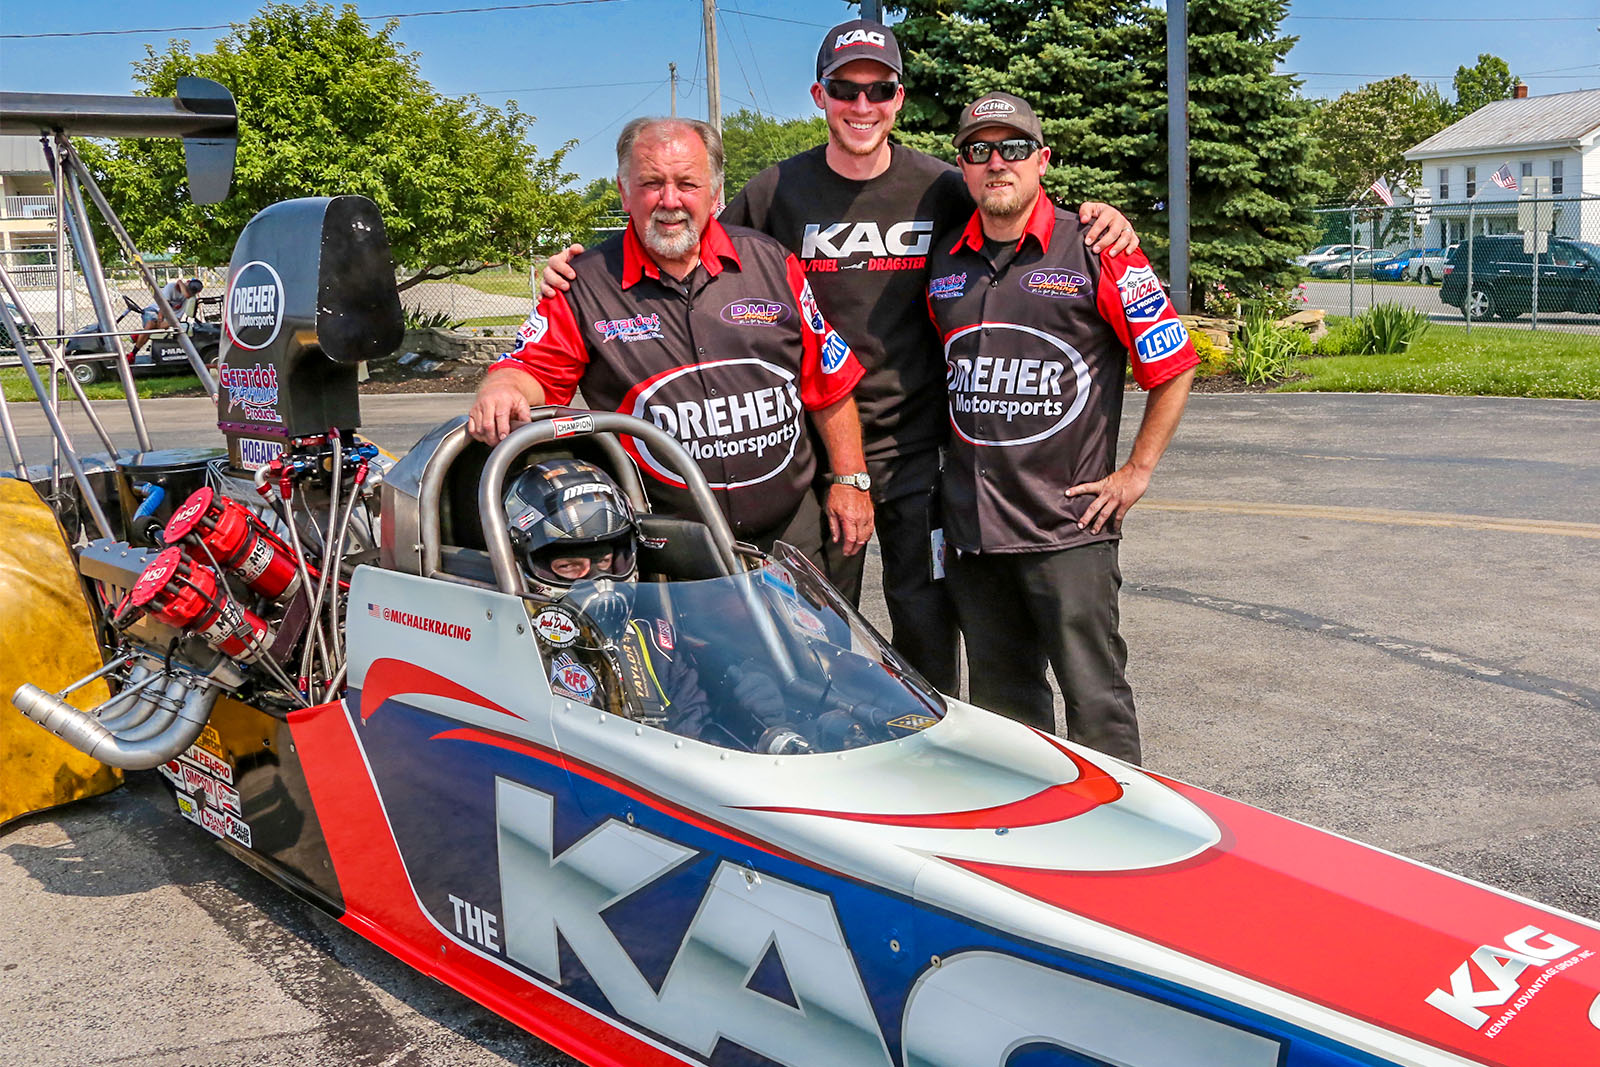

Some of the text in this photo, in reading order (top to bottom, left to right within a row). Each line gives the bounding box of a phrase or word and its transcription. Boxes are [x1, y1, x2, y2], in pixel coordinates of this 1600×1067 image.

[835, 29, 885, 49] KAG
[979, 102, 1010, 113] DREHER
[801, 221, 934, 258] KAG
[799, 256, 927, 273] A/FUEL DRAGSTER
[1029, 272, 1087, 288] DMP
[1125, 279, 1158, 306] LUCAS
[233, 284, 276, 314] DREHER
[731, 303, 782, 317] DMP
[1126, 305, 1138, 316] OIL
[1143, 304, 1157, 315] INC.
[240, 314, 275, 330] Motorsports
[594, 313, 660, 334] Gerardot
[220, 363, 278, 390] Gerardot
[947, 356, 1065, 396] DREHER
[244, 406, 277, 420] Products
[649, 385, 794, 441] DREHER
[955, 393, 1063, 422] Motorsports
[557, 419, 592, 433] CHAMPION
[242, 440, 282, 464] HOGAN'S
[682, 422, 796, 461] Motorsports
[172, 503, 201, 524] MSD
[250, 538, 267, 566] MSD
[140, 567, 167, 583] MSD
[383, 607, 472, 642] @MICHALEKRACING
[565, 669, 588, 690] RFC
[623, 644, 645, 697] TAYLOR
[199, 751, 230, 779] FEL-PRO
[185, 768, 214, 796] SIMPSON
[448, 893, 500, 954] THE
[1424, 924, 1581, 1031] KAG
[1485, 949, 1597, 1039] KENAN ADVANTAGE GROUP, INC.
